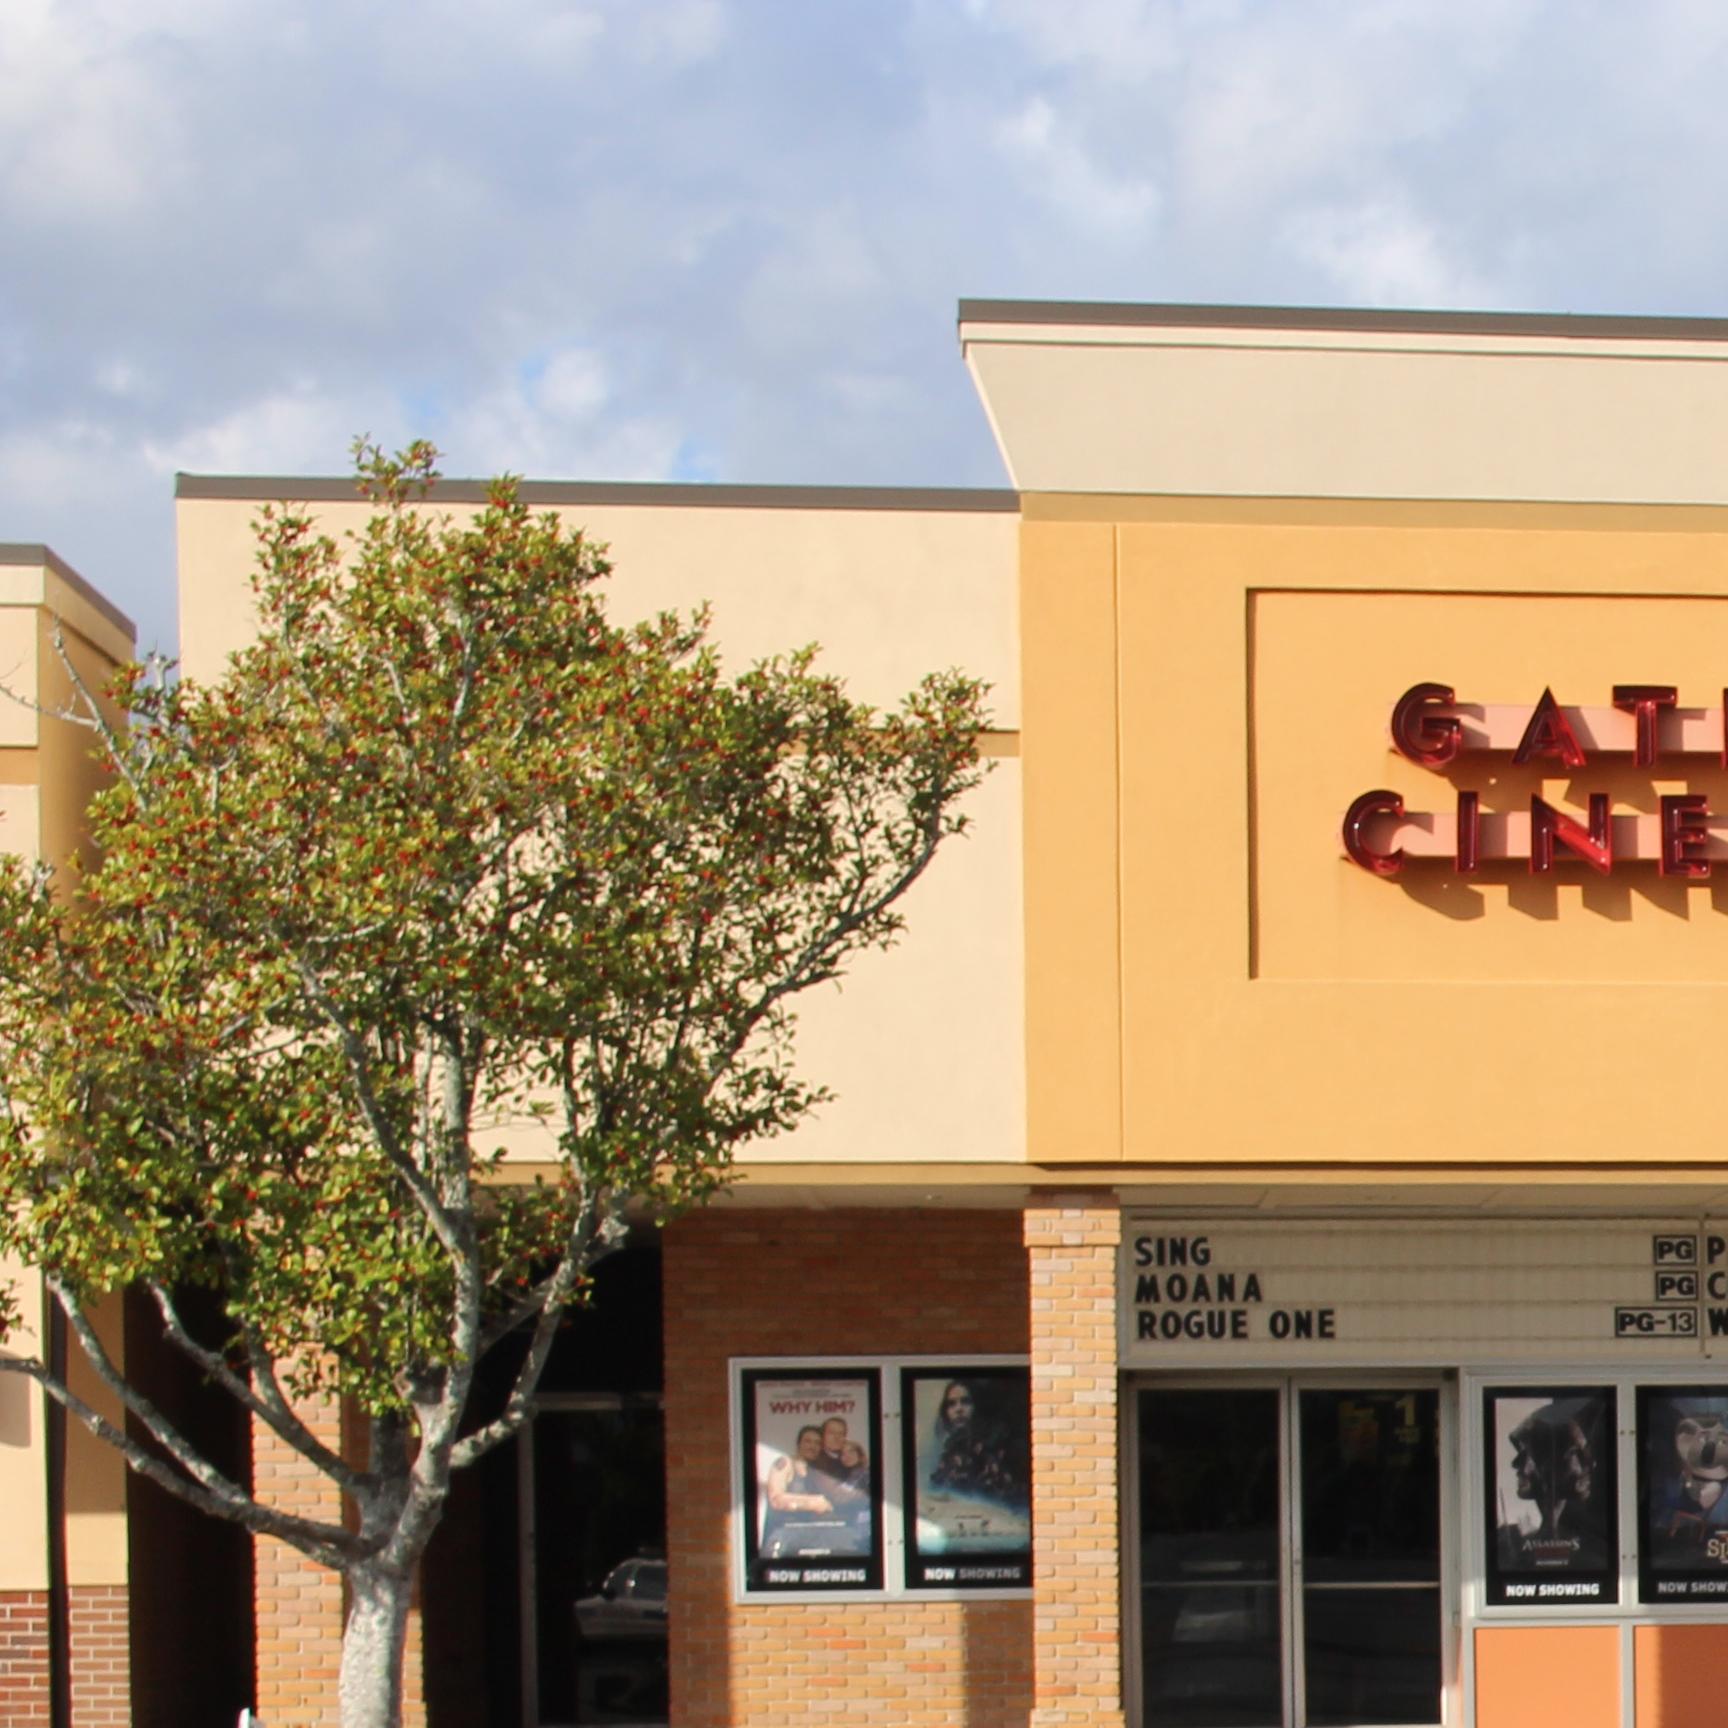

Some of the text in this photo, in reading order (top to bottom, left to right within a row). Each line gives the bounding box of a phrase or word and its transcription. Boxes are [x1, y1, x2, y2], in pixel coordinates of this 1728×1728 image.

[1134, 1236, 1693, 1267] SING PG
[1134, 1273, 1695, 1303] MOANA PG
[1138, 1309, 1693, 1340] ROGUE ONE PG-13
[769, 1401, 811, 1415] WHY
[768, 1568, 866, 1582] NOW SHOWING
[924, 1567, 1020, 1581] NOW SHOWING
[1506, 1583, 1600, 1597] NOW SHOWING
[1658, 1581, 1687, 1593] NOW
